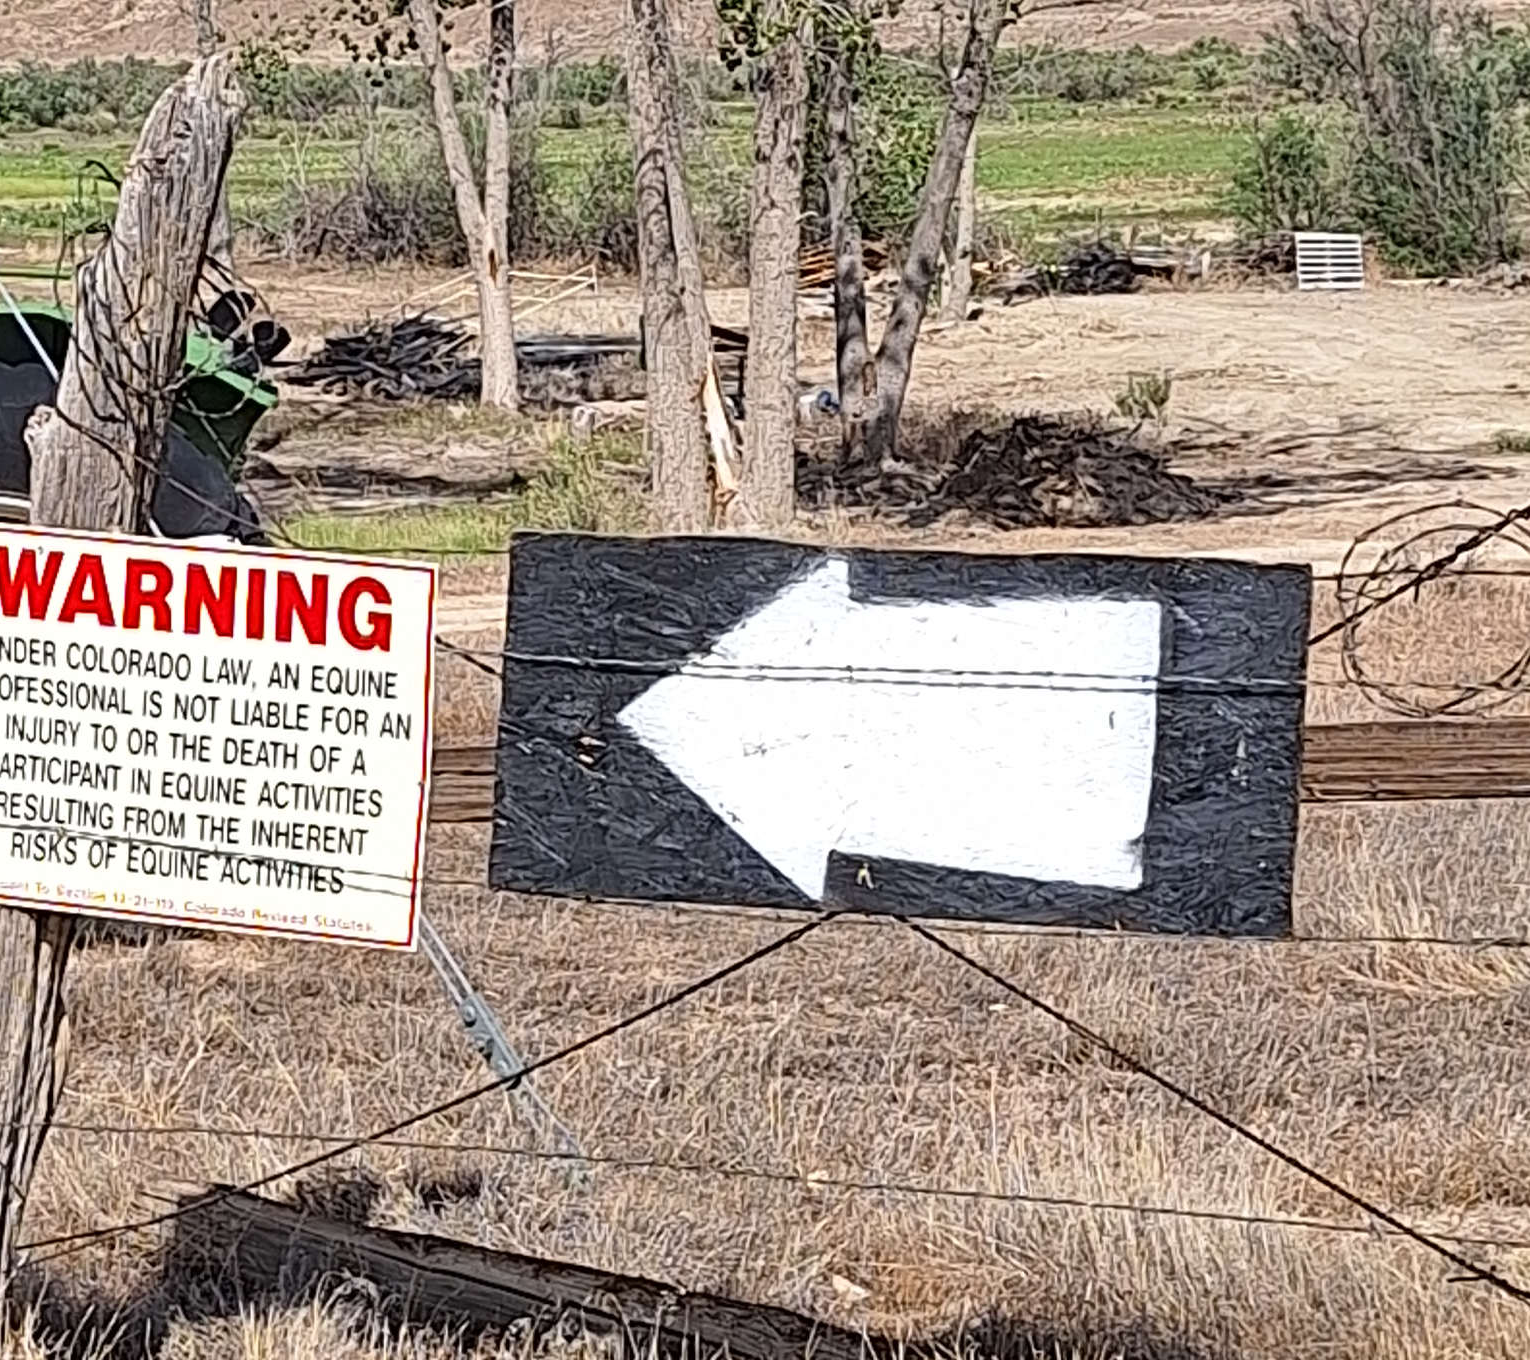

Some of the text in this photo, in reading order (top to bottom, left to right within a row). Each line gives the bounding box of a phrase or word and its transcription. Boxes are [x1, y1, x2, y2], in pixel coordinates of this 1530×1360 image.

[66, 643, 190, 681] COLORADO
[202, 655, 257, 689] LAW,
[268, 662, 300, 690] AN
[312, 665, 398, 699] EQUINE
[143, 691, 163, 718] IS
[174, 695, 220, 724] NOT
[231, 700, 309, 731] LIABLE
[321, 707, 367, 737] FOR
[379, 713, 412, 741] AN
[6, 714, 366, 775] INJURY TO OR THE DEATH OF A
[131, 767, 151, 795] IN
[161, 772, 246, 805] EQUINE
[258, 781, 383, 817] ACTIVITIES
[124, 807, 186, 838] FROM
[197, 814, 239, 843] THE
[252, 820, 368, 856] INHERENT
[11, 833, 344, 893] RISKS OF EQUINE ACTIVITIES
